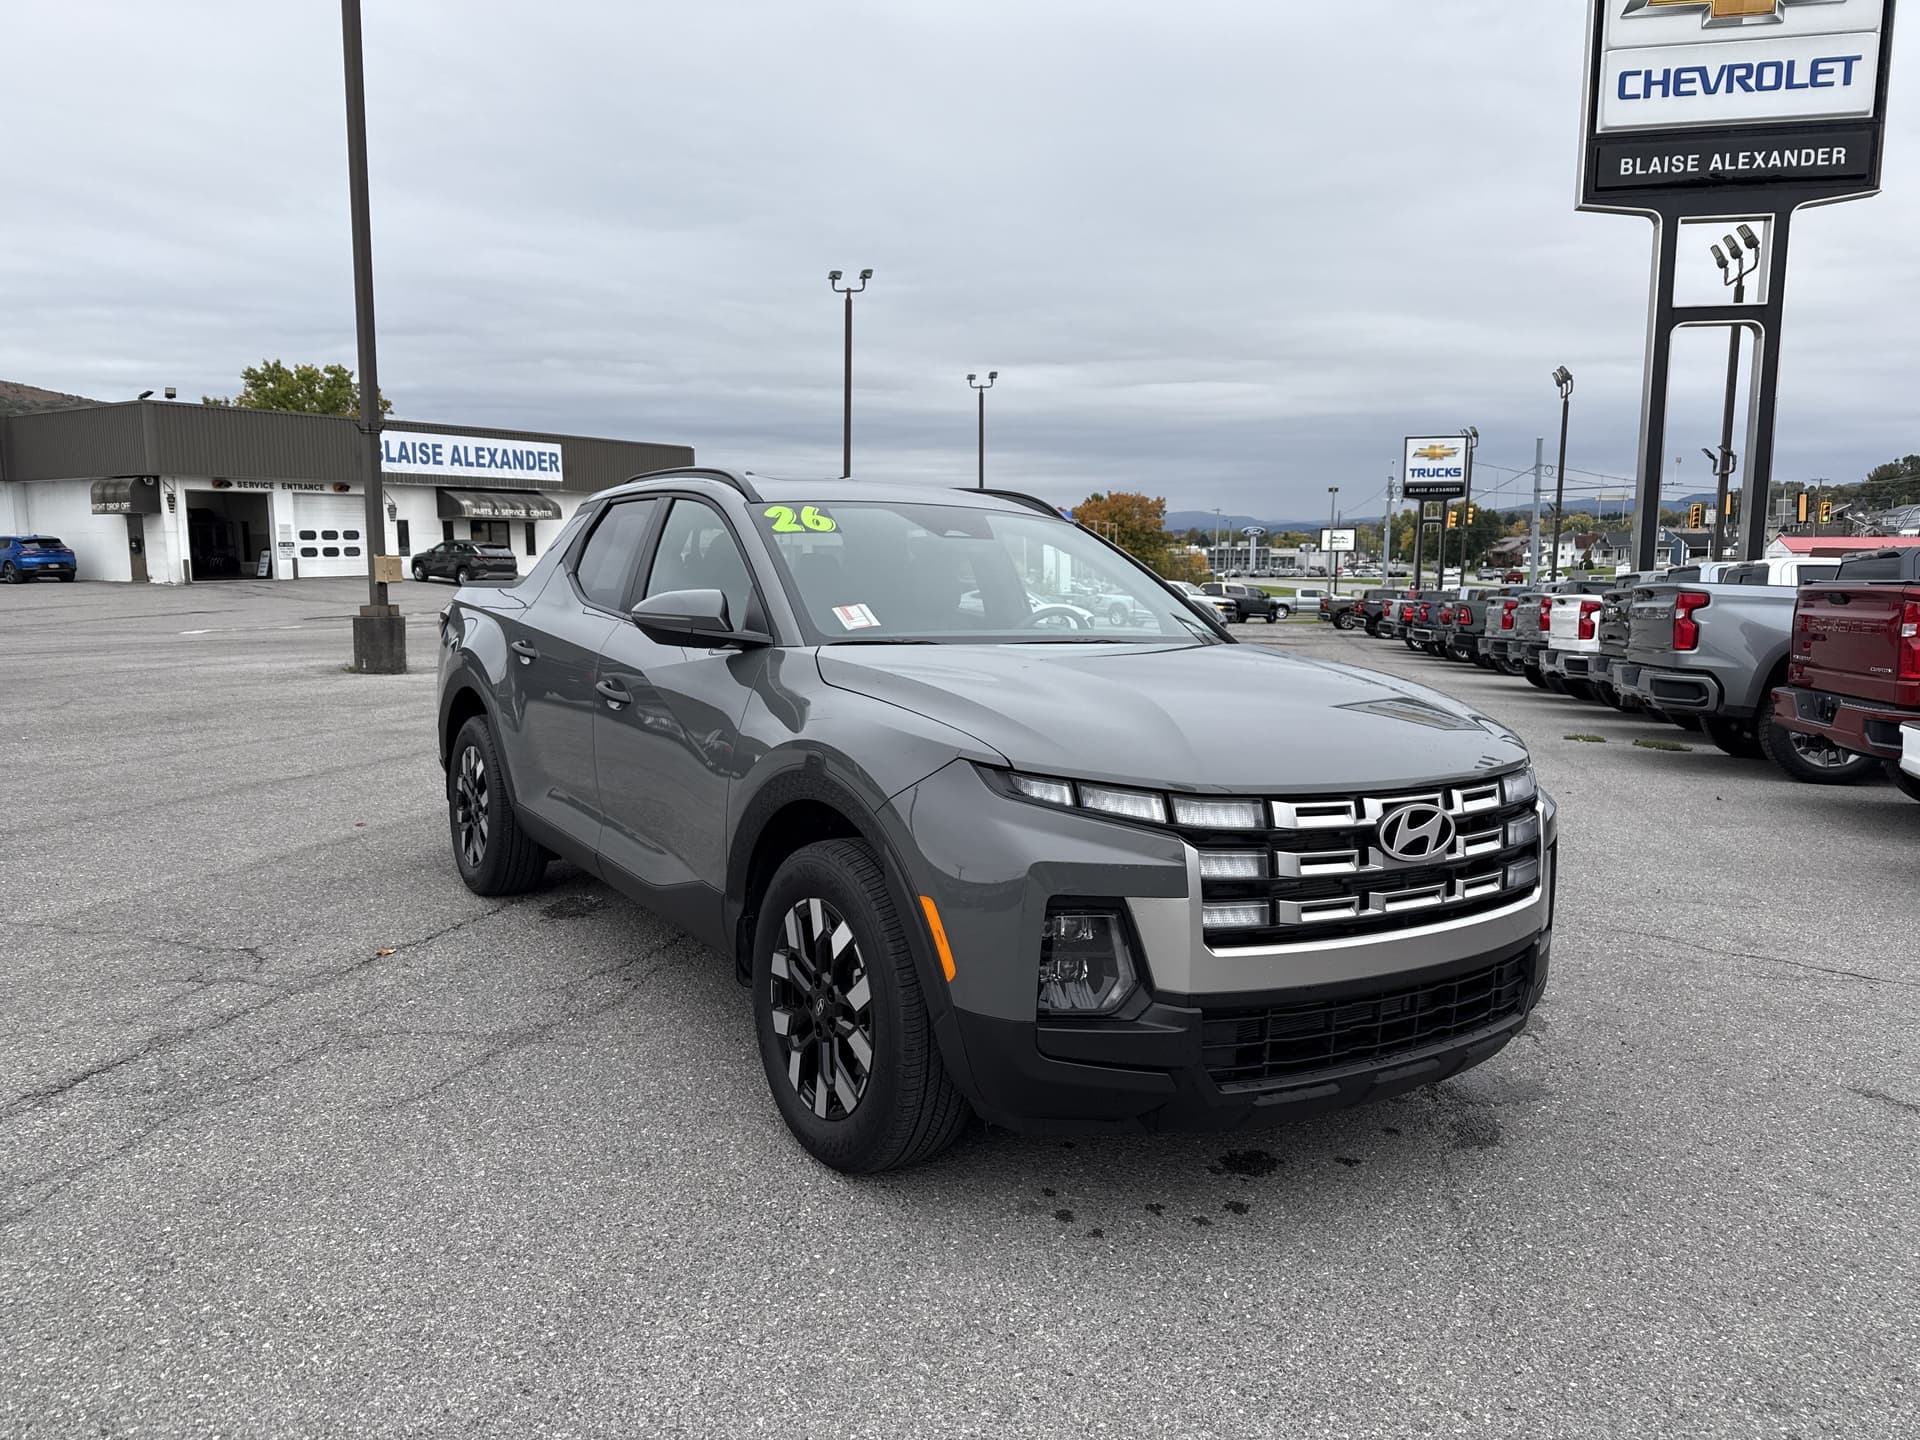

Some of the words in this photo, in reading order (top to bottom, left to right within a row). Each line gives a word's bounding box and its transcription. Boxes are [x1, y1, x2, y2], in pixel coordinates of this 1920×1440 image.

[1617, 54, 1862, 101] CHEVROLET
[1619, 153, 1700, 176] BLAISE
[1709, 147, 1847, 171] ALEXANDER
[381, 440, 443, 465] LAISE
[450, 445, 560, 472] ALEXANDER
[1409, 467, 1462, 478] TRUCKS
[236, 480, 275, 490] SERVICE
[281, 482, 325, 492] ENTRANCE
[106, 502, 120, 511] DROP
[120, 501, 131, 511] OFF
[472, 507, 493, 516] PARTS
[501, 508, 526, 517] SERVICE
[529, 509, 553, 517] CENTER
[763, 505, 837, 533] 26
